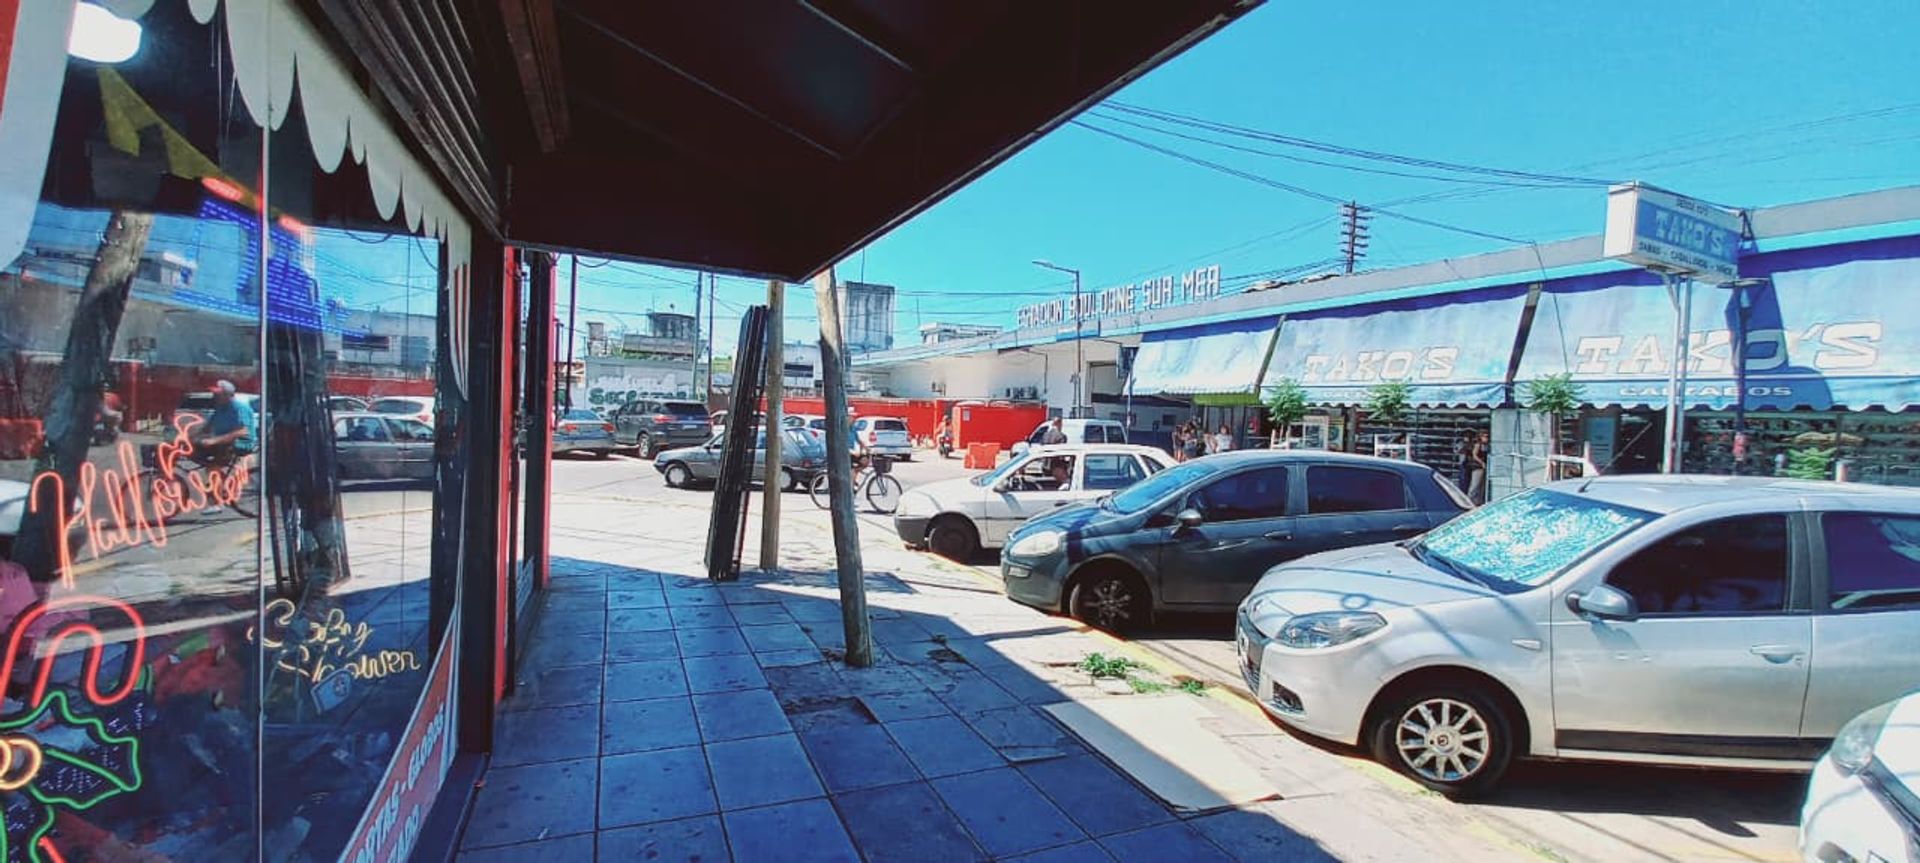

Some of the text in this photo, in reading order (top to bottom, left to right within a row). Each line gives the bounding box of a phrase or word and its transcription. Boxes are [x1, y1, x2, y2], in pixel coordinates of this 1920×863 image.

[1655, 209, 1724, 257] TAKO'S
[1141, 275, 1175, 306] SUR
[1181, 264, 1221, 301] MER
[1302, 346, 1459, 382] TAKO'S
[1575, 321, 1882, 374] TAKO'S
